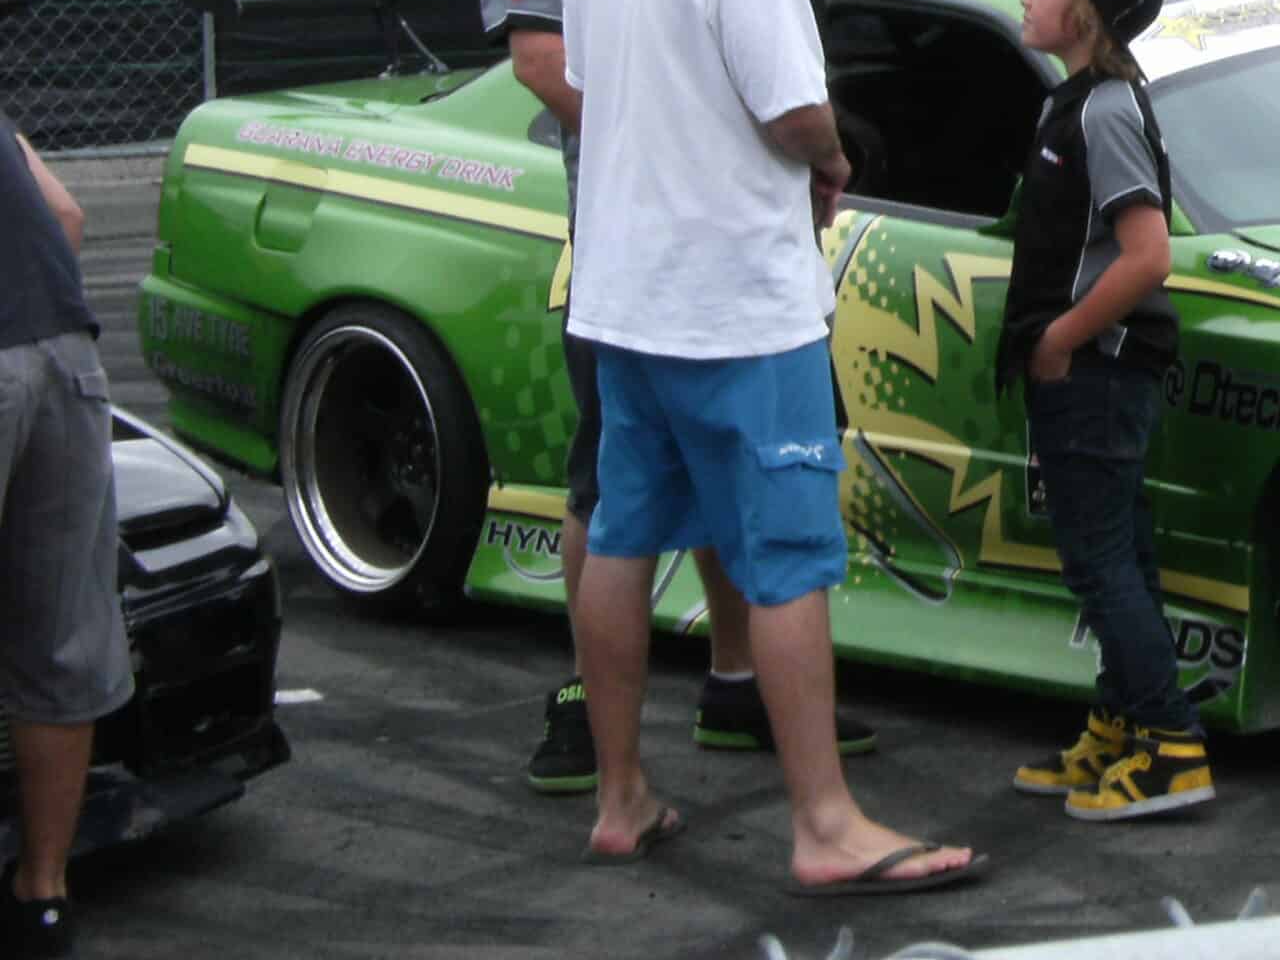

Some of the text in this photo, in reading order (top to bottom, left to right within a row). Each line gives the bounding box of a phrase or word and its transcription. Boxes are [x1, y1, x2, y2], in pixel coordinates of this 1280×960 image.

[344, 140, 438, 173] ENERGY
[438, 157, 524, 191] DRINK
[485, 520, 565, 556] HYN
